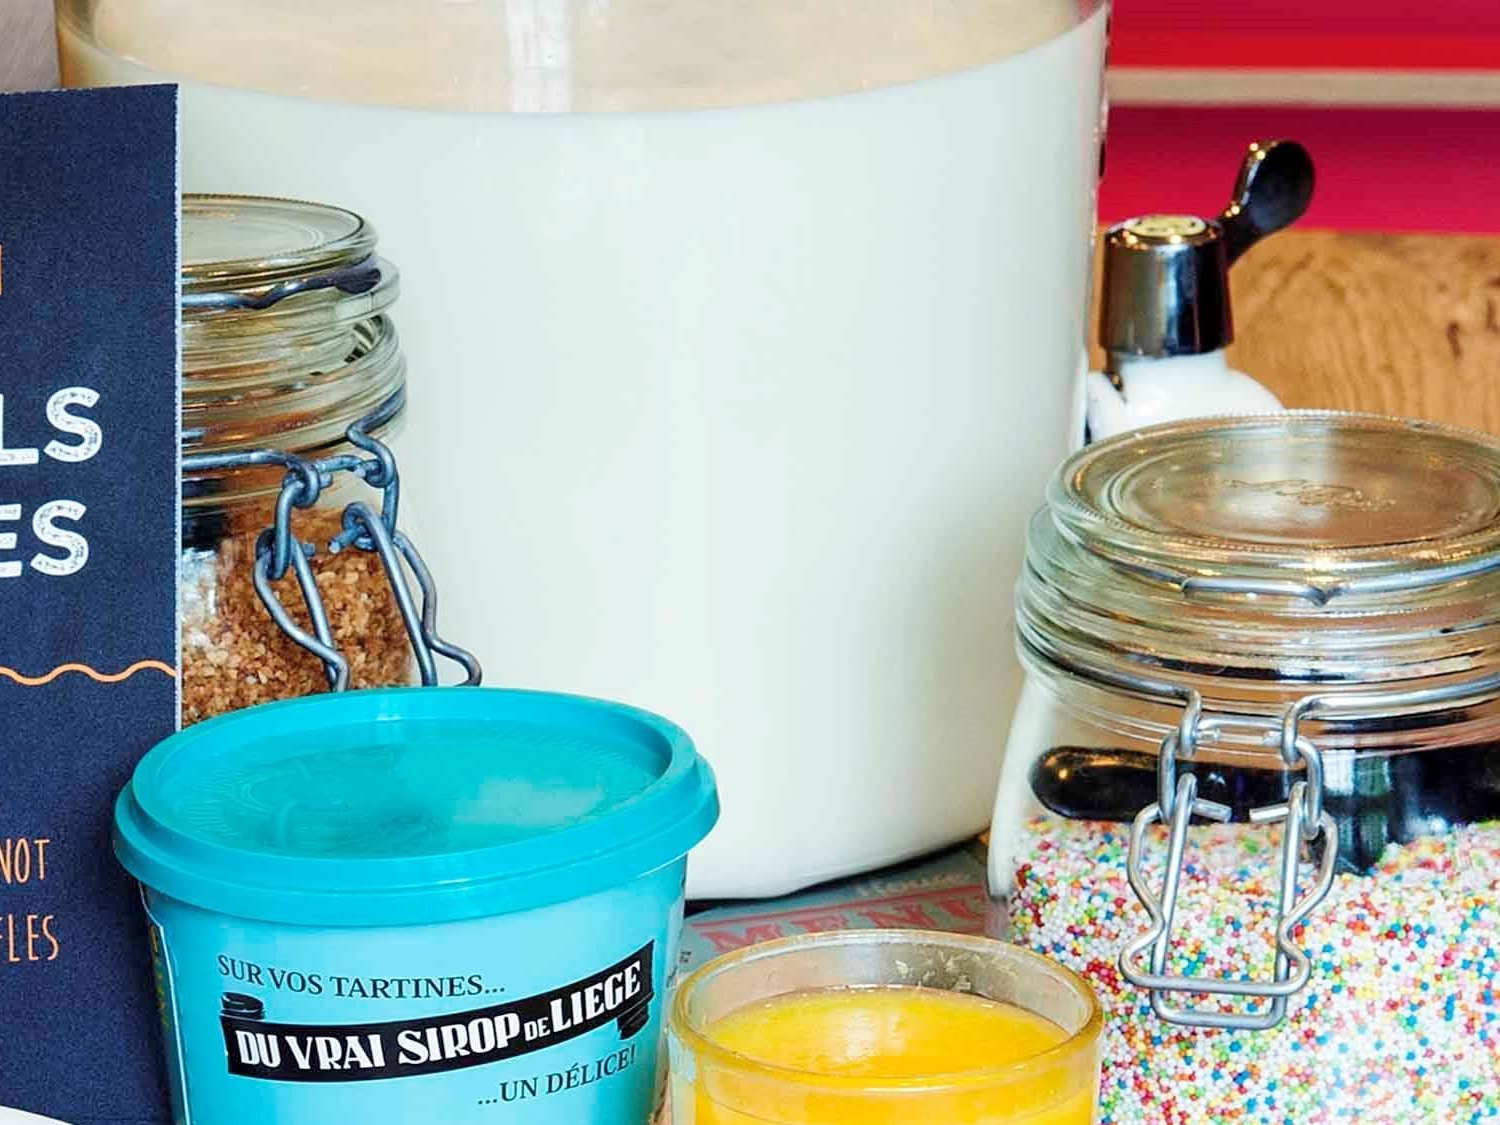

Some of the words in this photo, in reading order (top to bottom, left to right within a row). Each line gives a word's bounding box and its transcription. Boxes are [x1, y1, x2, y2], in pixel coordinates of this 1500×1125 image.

[217, 954, 264, 986] SUR
[268, 968, 323, 995] VOS
[235, 1029, 281, 1068] DU
[285, 1034, 386, 1070] VRAI
[397, 1012, 523, 1066] SIROP
[549, 960, 642, 1034] LIEGE
[545, 1047, 636, 1095] DÉLICE!
